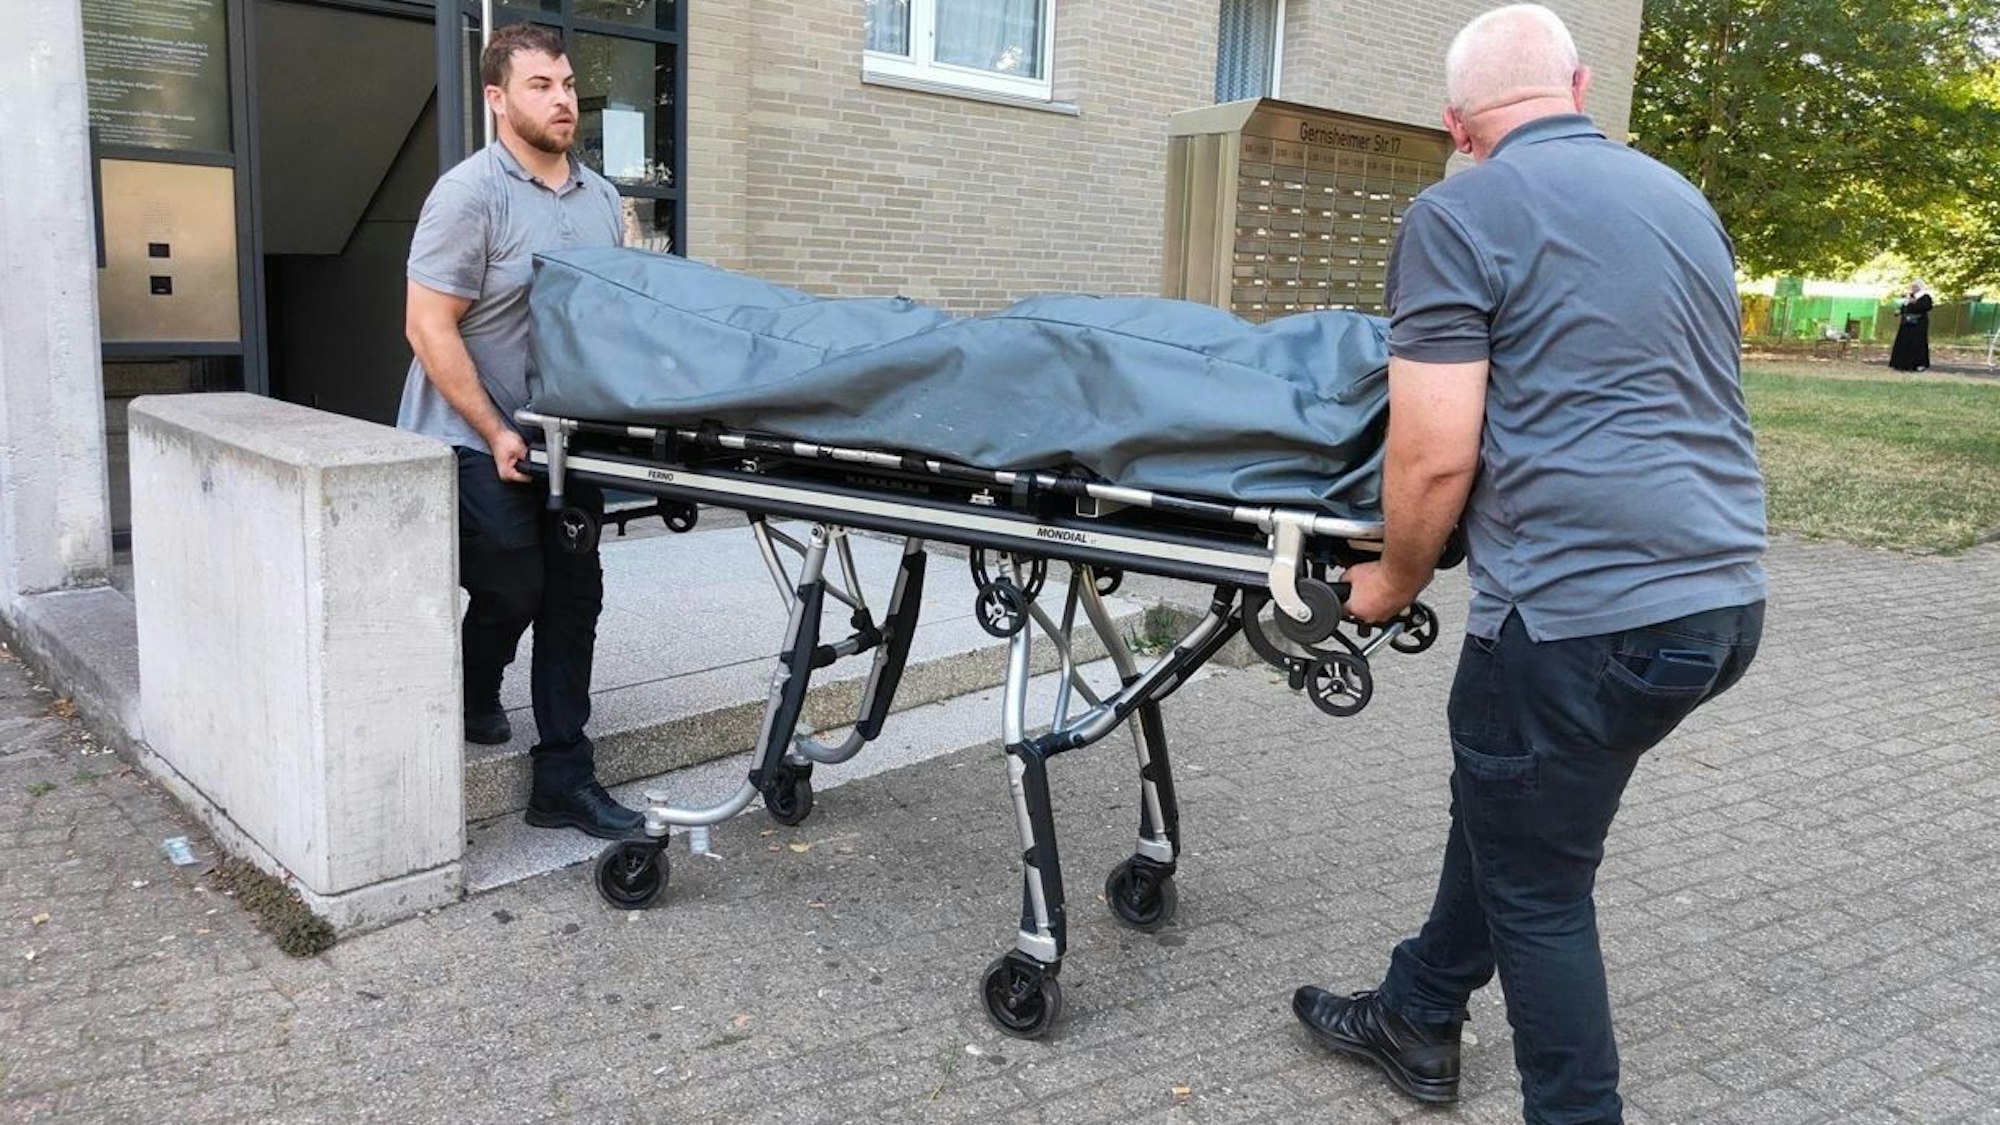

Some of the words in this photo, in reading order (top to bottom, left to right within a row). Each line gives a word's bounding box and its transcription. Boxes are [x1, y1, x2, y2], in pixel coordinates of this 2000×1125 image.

[1300, 121, 1370, 150] Gernsheimer
[648, 469, 674, 482] FERNO
[1037, 527, 1087, 543] MONDIAL
